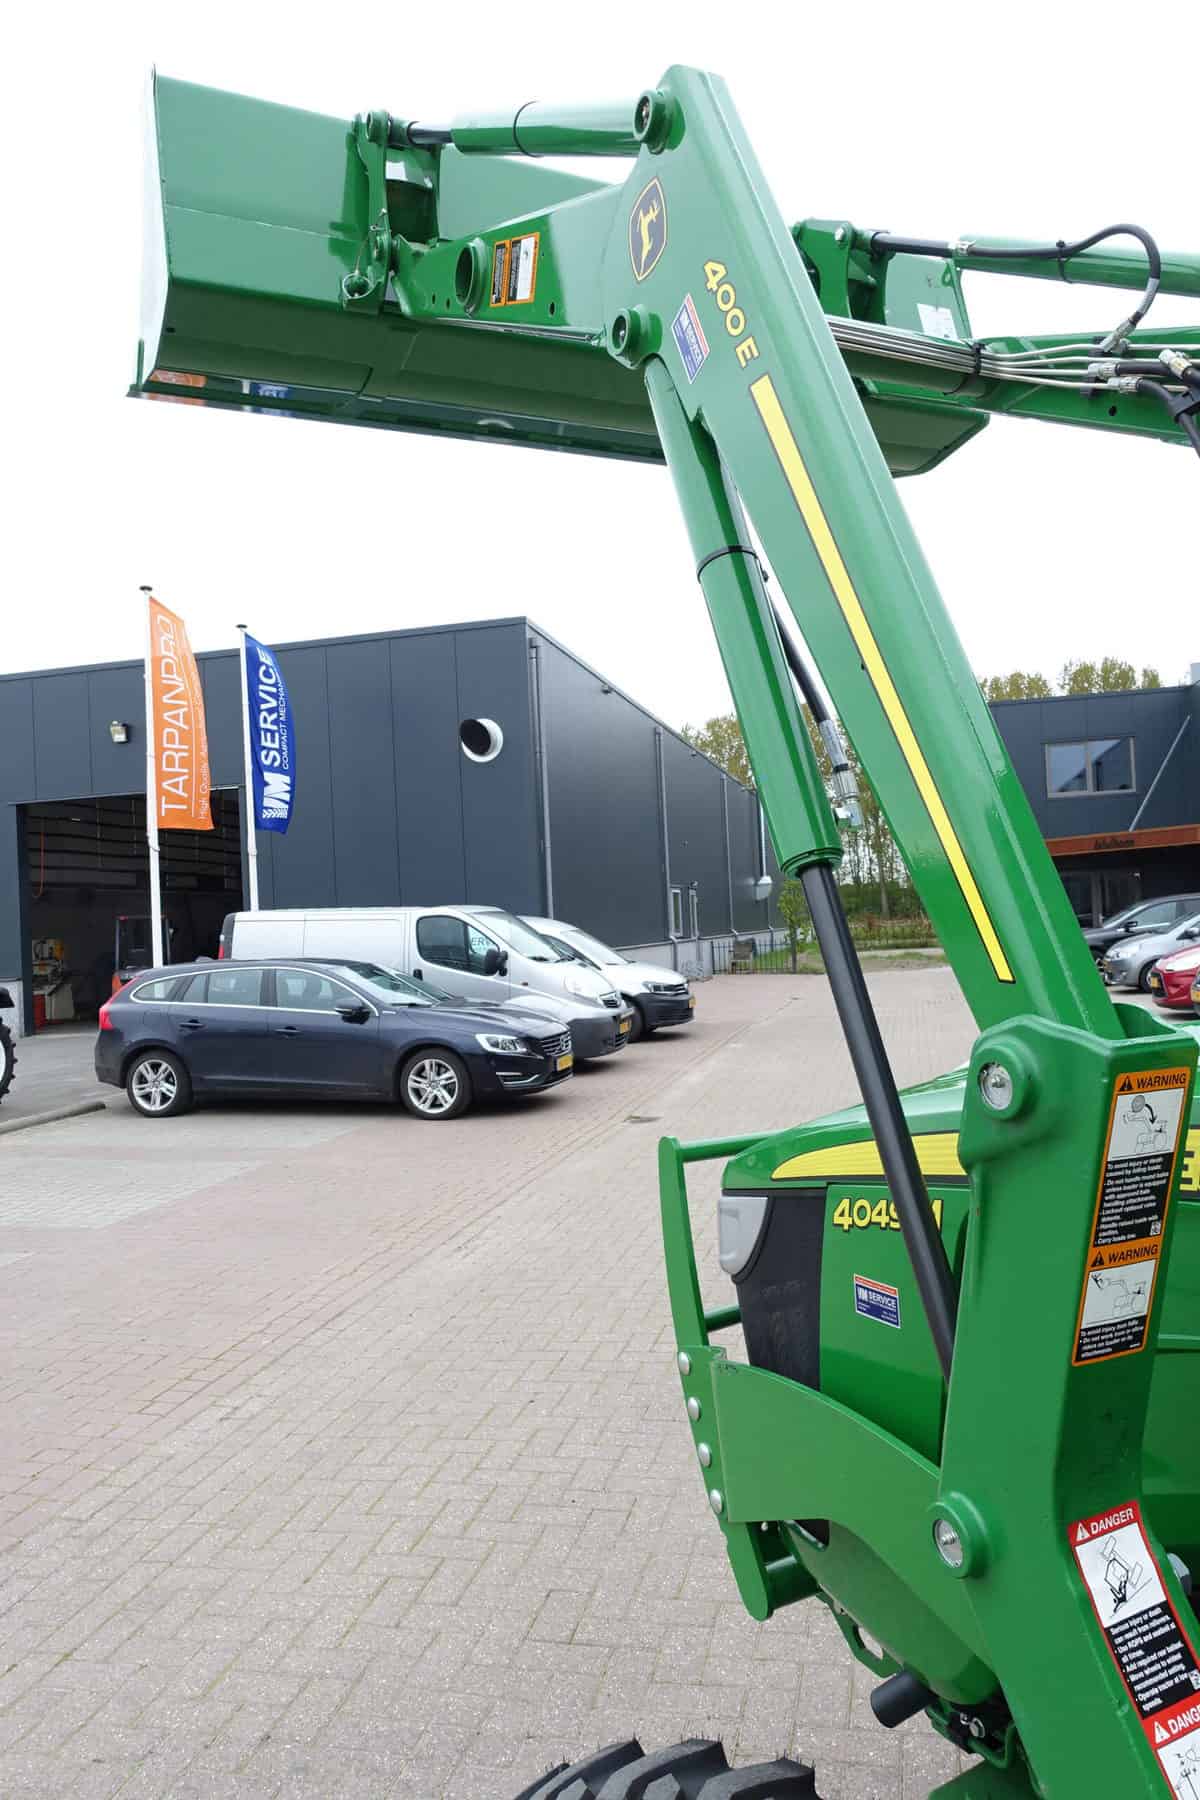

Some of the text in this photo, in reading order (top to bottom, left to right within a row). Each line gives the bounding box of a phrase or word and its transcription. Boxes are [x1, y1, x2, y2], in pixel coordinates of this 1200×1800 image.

[704, 260, 760, 368] 400 E
[256, 646, 282, 767] SERVICE
[281, 724, 289, 770] COMPACT
[1136, 1073, 1187, 1090] WARNING
[1108, 1244, 1158, 1265] WARNING
[868, 1291, 897, 1308] SERVICE
[1090, 1507, 1135, 1535] DANGER
